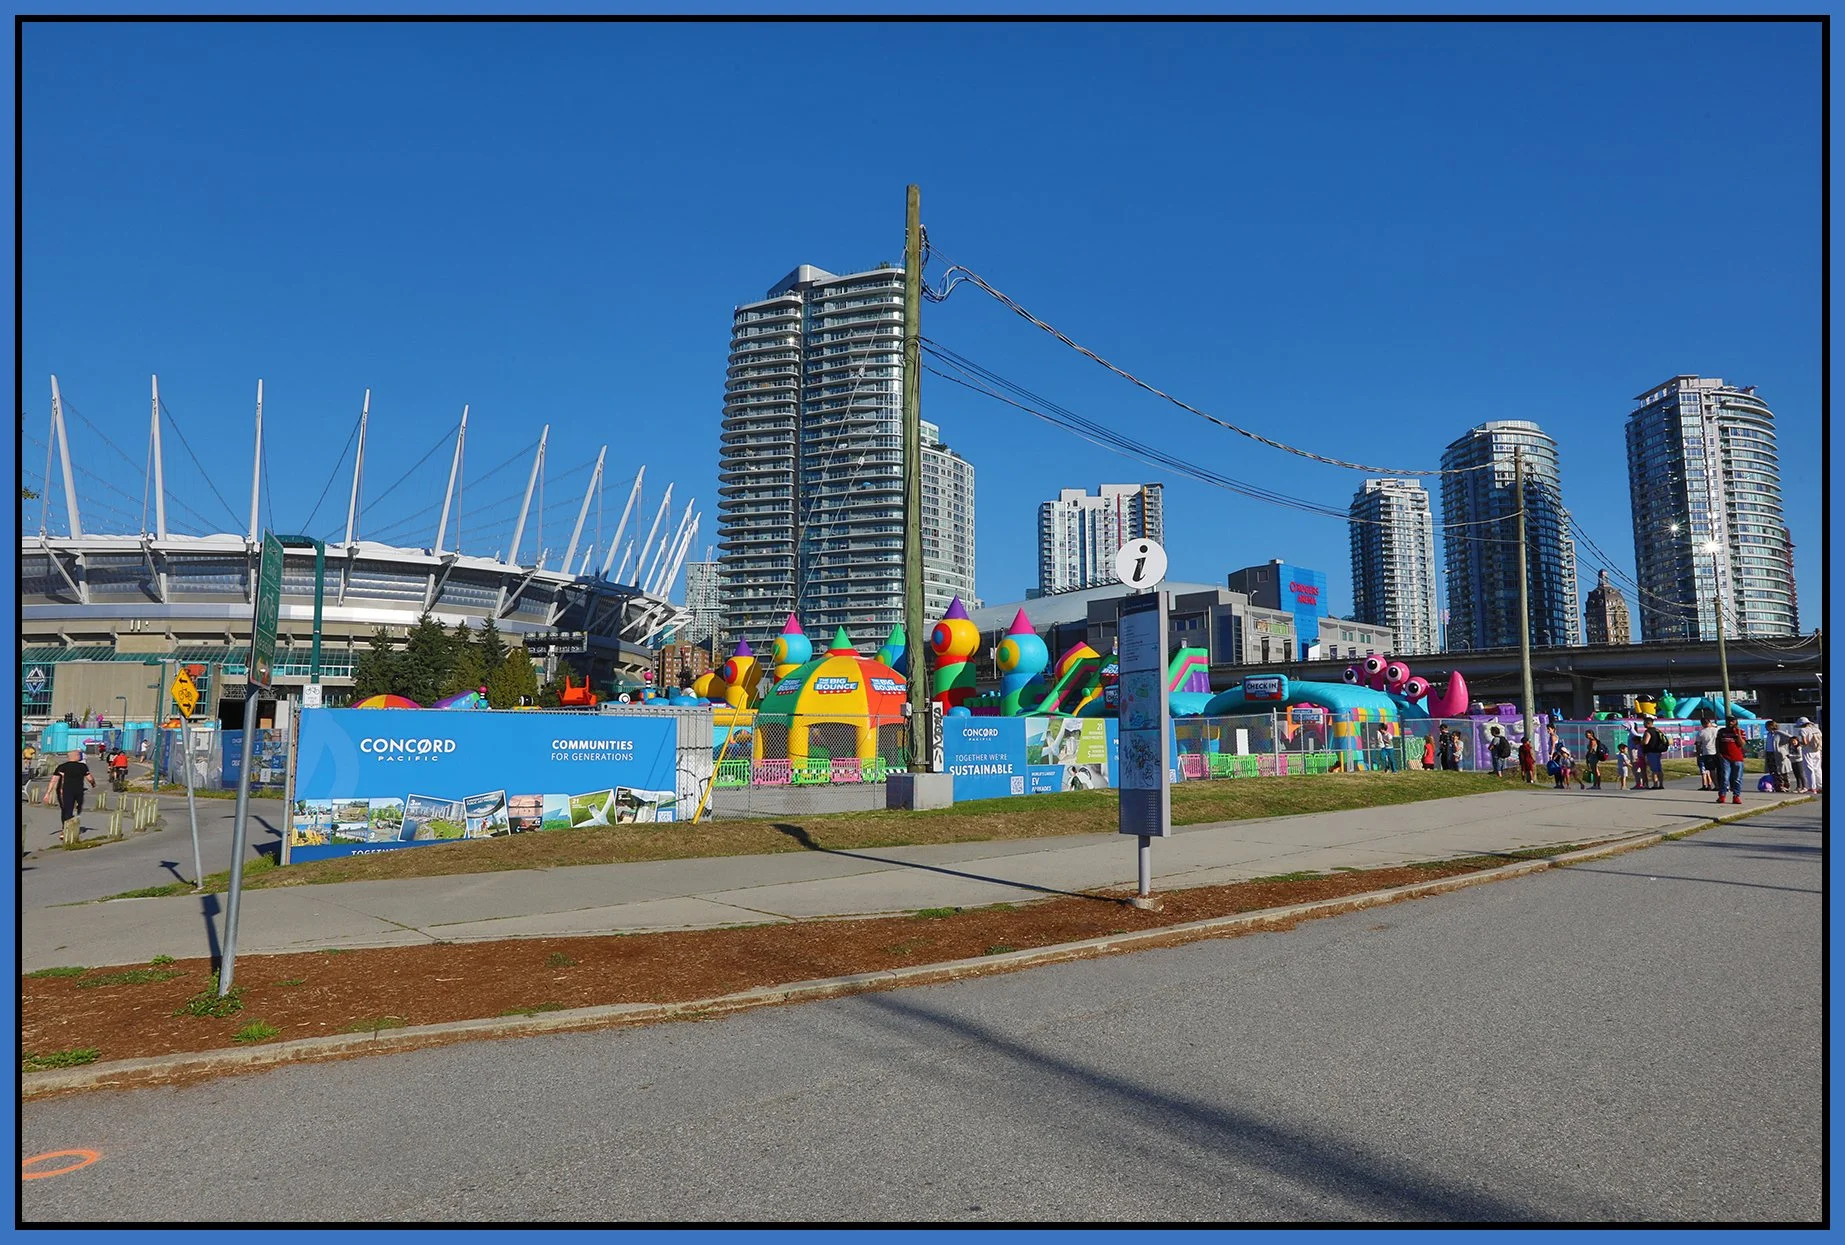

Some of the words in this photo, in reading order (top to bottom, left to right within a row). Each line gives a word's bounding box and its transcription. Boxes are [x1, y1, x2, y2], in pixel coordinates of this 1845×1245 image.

[1298, 594, 1316, 605] ARENA
[873, 684, 906, 692] BOUNCE
[1246, 682, 1268, 690] CHECK
[552, 740, 633, 750] COMMUNITIES
[551, 753, 569, 761] FOR
[571, 753, 634, 761] GENERATIONS
[955, 754, 988, 762] TOGETHER
[949, 764, 1013, 776] SUSTAINABLE
[1031, 777, 1040, 786] EV
